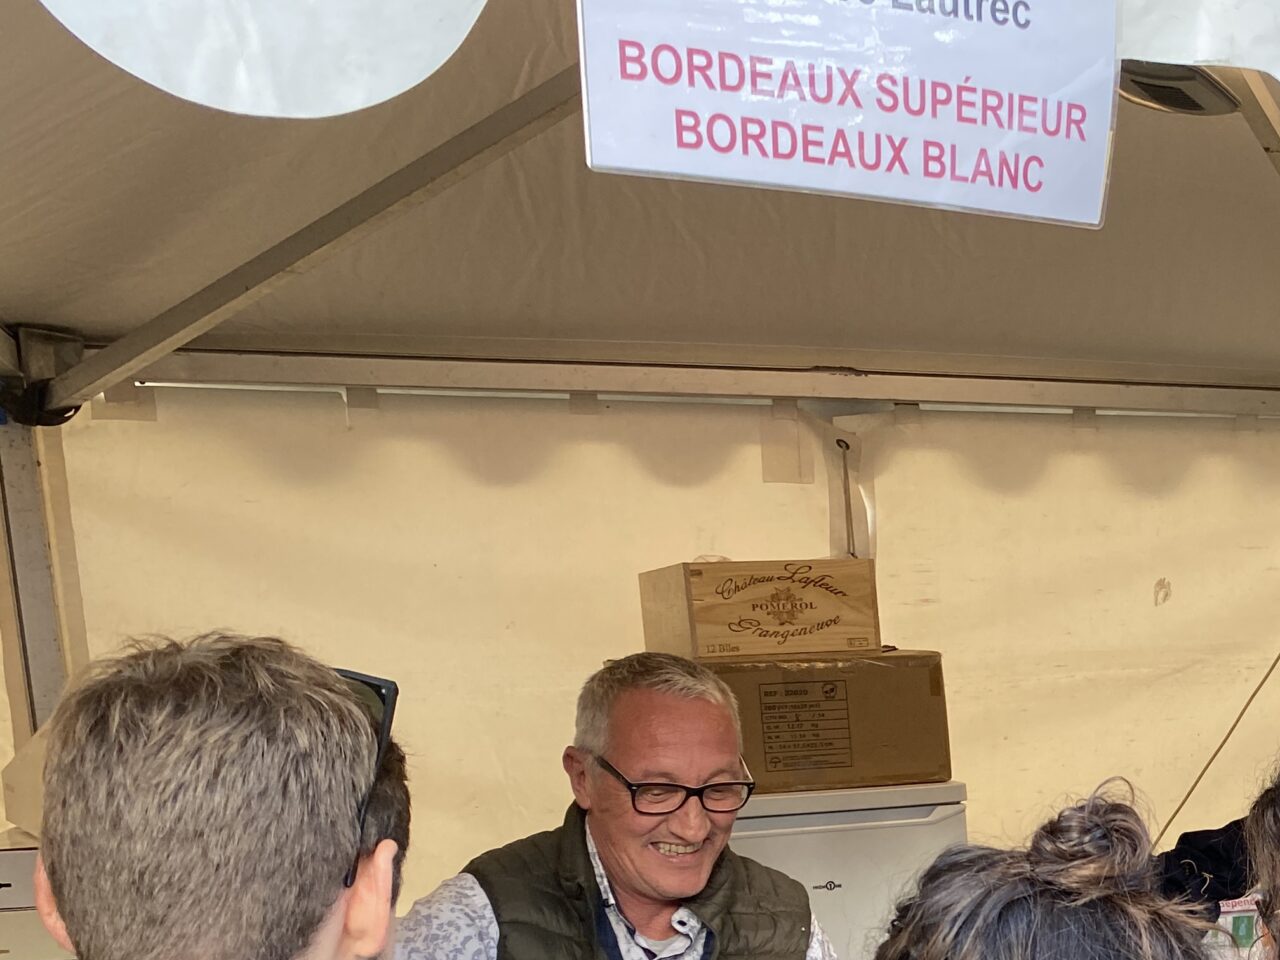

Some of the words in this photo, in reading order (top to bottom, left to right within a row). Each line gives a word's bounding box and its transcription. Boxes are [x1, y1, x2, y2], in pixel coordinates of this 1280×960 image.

[891, 0, 1031, 29] utrec
[617, 39, 863, 109] BORDEAUX
[876, 75, 1088, 142] SUPÉRIEUR
[674, 108, 910, 175] BORDEAUX
[923, 139, 1046, 194] BLANC
[715, 574, 774, 600] Château
[776, 563, 849, 597] Lafleur
[751, 601, 818, 612] POMEROL
[728, 615, 841, 645] Grangeneuve
[706, 645, 717, 654] 12
